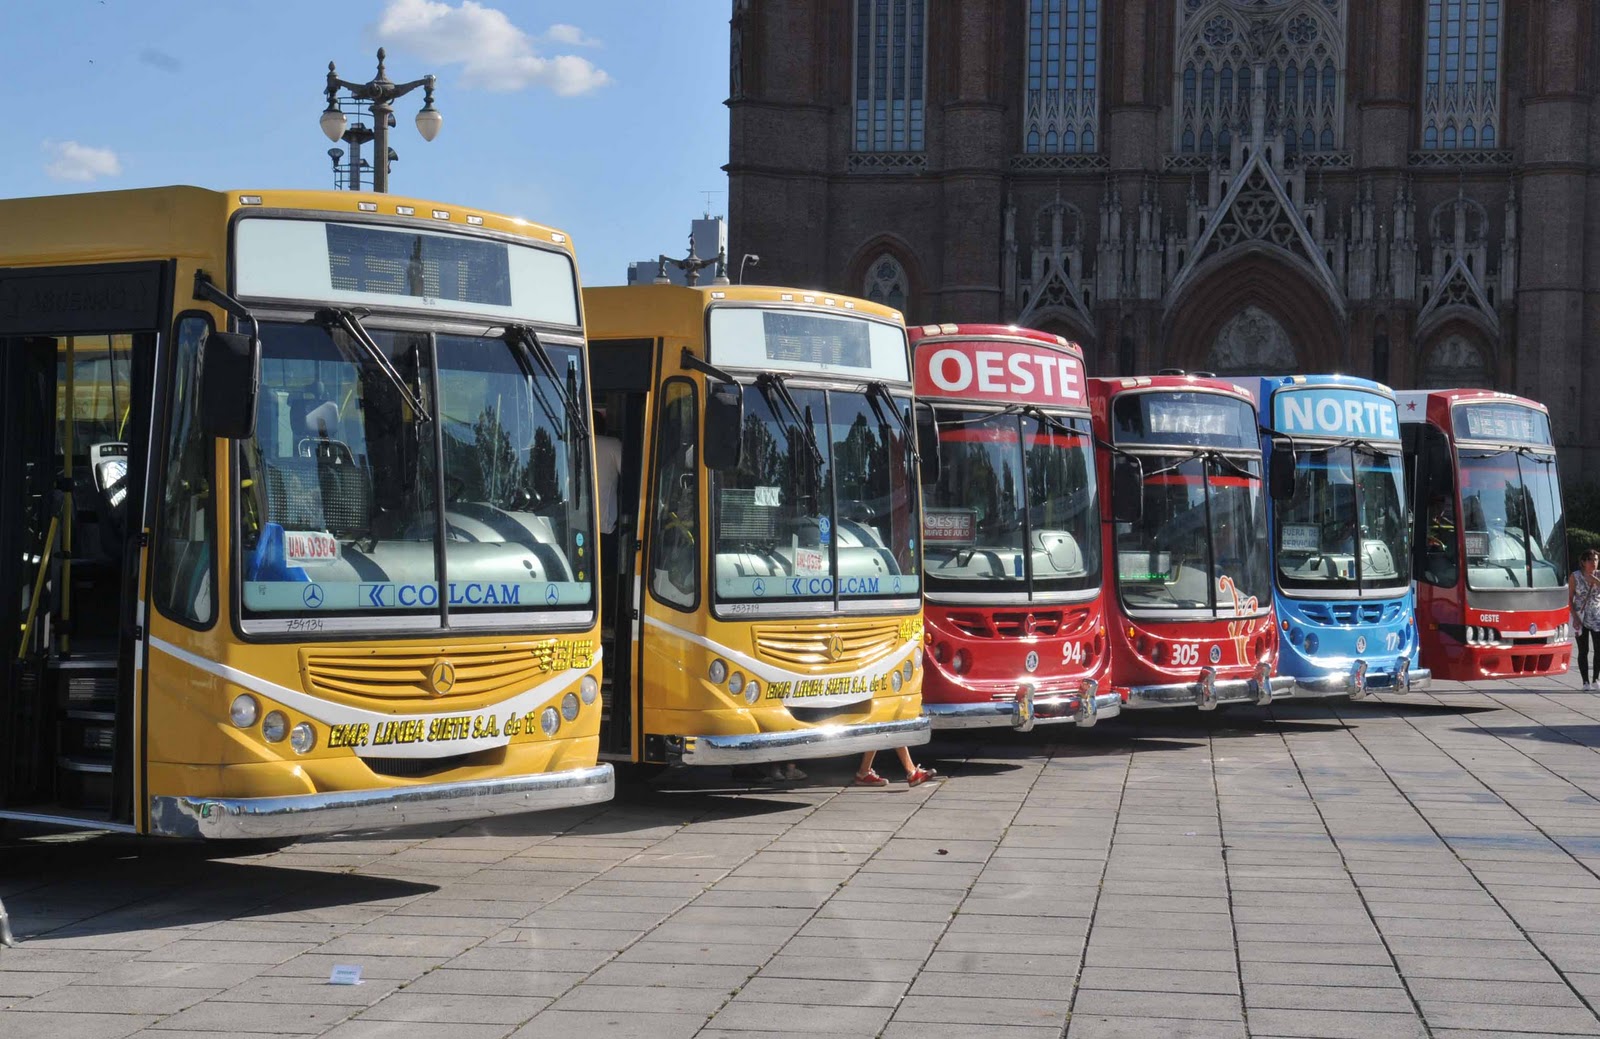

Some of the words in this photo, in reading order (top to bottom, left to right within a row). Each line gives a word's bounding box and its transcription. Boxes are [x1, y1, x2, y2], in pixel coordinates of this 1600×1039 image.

[929, 349, 1080, 399] OESTE
[1283, 397, 1394, 437] NORTE
[925, 515, 970, 528] OESTE
[925, 529, 943, 537] NUEVE
[944, 529, 952, 537] DE
[953, 529, 969, 537] JULIO
[1283, 529, 1305, 537] FUERA
[398, 583, 520, 606] COLCAM
[809, 577, 880, 595] COLCAM
[1480, 614, 1500, 622] OESTE
[1062, 641, 1081, 665] 94
[1171, 644, 1199, 665] 305
[793, 679, 825, 698] LINEA
[825, 677, 851, 696] SIETE
[328, 721, 370, 748] EMP.
[372, 718, 426, 746] LINEA
[427, 715, 472, 742] SIETE
[472, 714, 500, 739] S.A.
[504, 712, 521, 736] de
